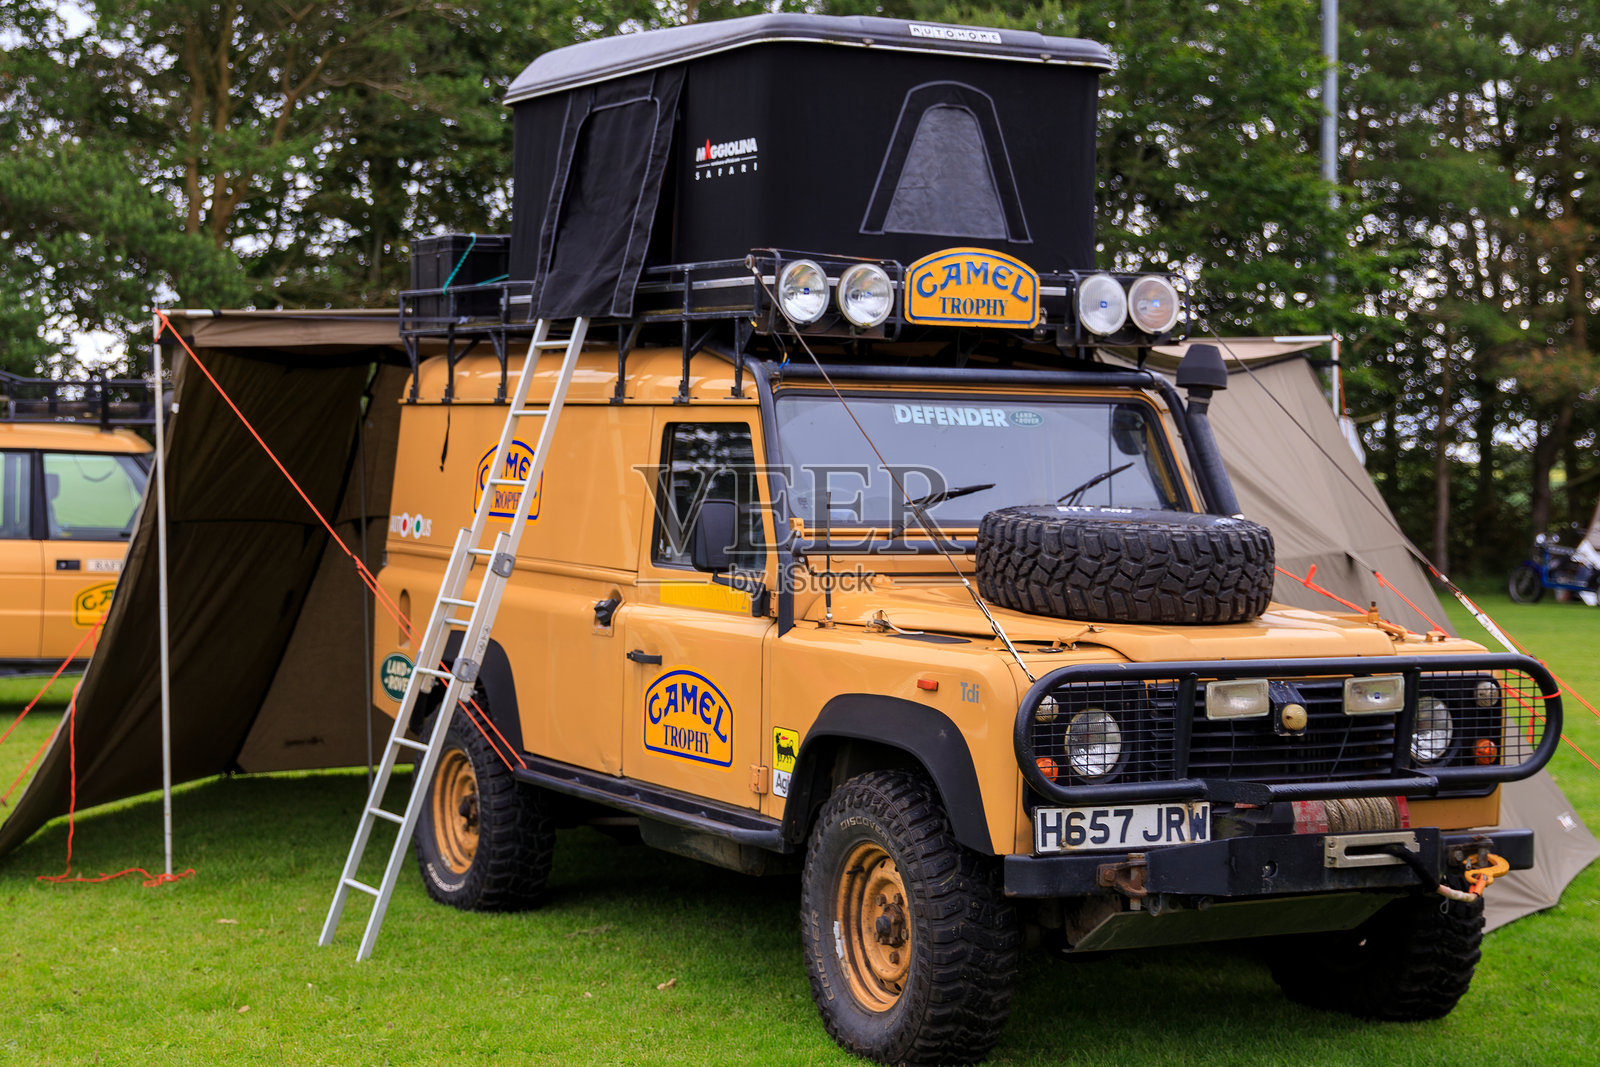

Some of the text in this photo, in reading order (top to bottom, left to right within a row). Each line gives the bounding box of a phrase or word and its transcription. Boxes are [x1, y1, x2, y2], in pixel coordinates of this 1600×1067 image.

[912, 26, 999, 41] AUTOHOME
[695, 137, 758, 162] MAGGIOLINA
[695, 162, 758, 181] SAFARI
[916, 261, 1029, 303] CAMEL
[939, 296, 1008, 316] TROPHY
[894, 404, 1010, 427] DEFENDER
[386, 659, 408, 676] LAND
[387, 675, 409, 693] ROVE
[960, 681, 980, 704] Tdi
[649, 682, 727, 743] CAMEL
[663, 723, 709, 754] TROPHY
[1041, 805, 1208, 847] H657 JRW
